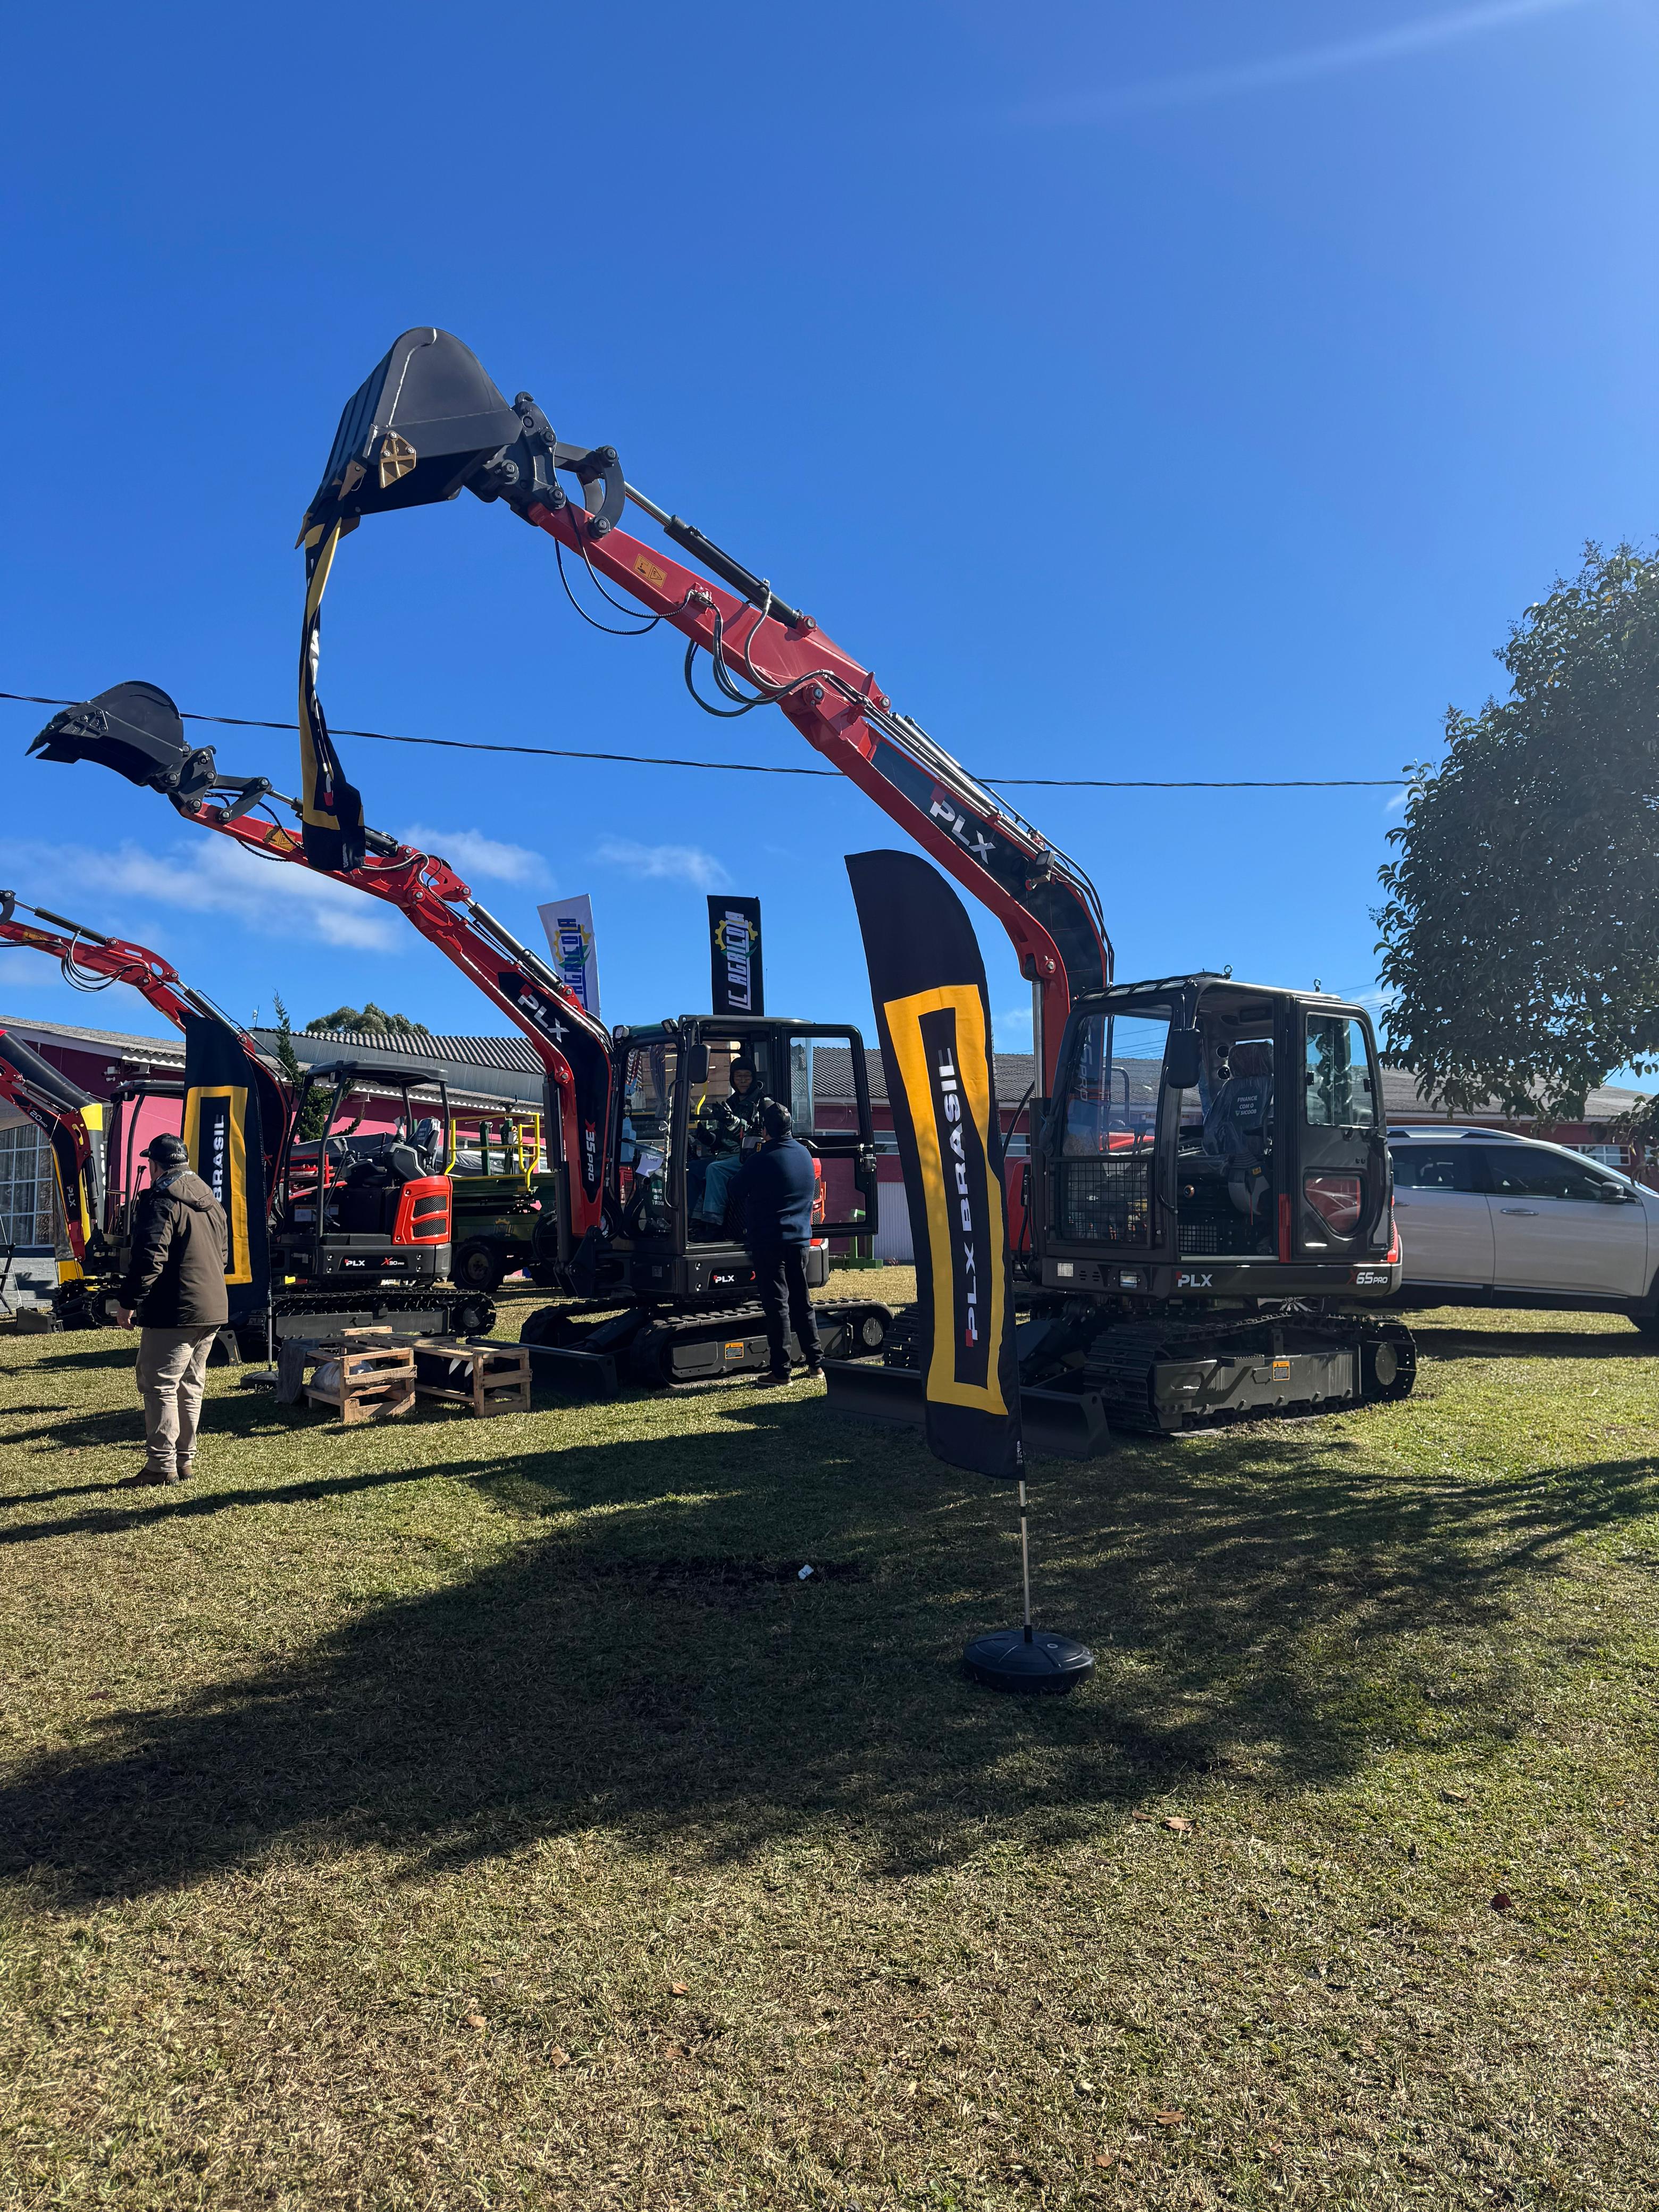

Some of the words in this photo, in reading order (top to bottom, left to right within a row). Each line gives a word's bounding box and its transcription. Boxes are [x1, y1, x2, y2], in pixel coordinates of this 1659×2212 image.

[929, 787, 996, 865] PLX
[517, 984, 570, 1043] PLX
[213, 1115, 224, 1203] BRASIL
[938, 1048, 973, 1231] BRASIL
[66, 1184, 76, 1207] PLX
[714, 1275, 735, 1284] PLX
[964, 1242, 979, 1346] PLX
[1176, 1271, 1213, 1287] PLX
